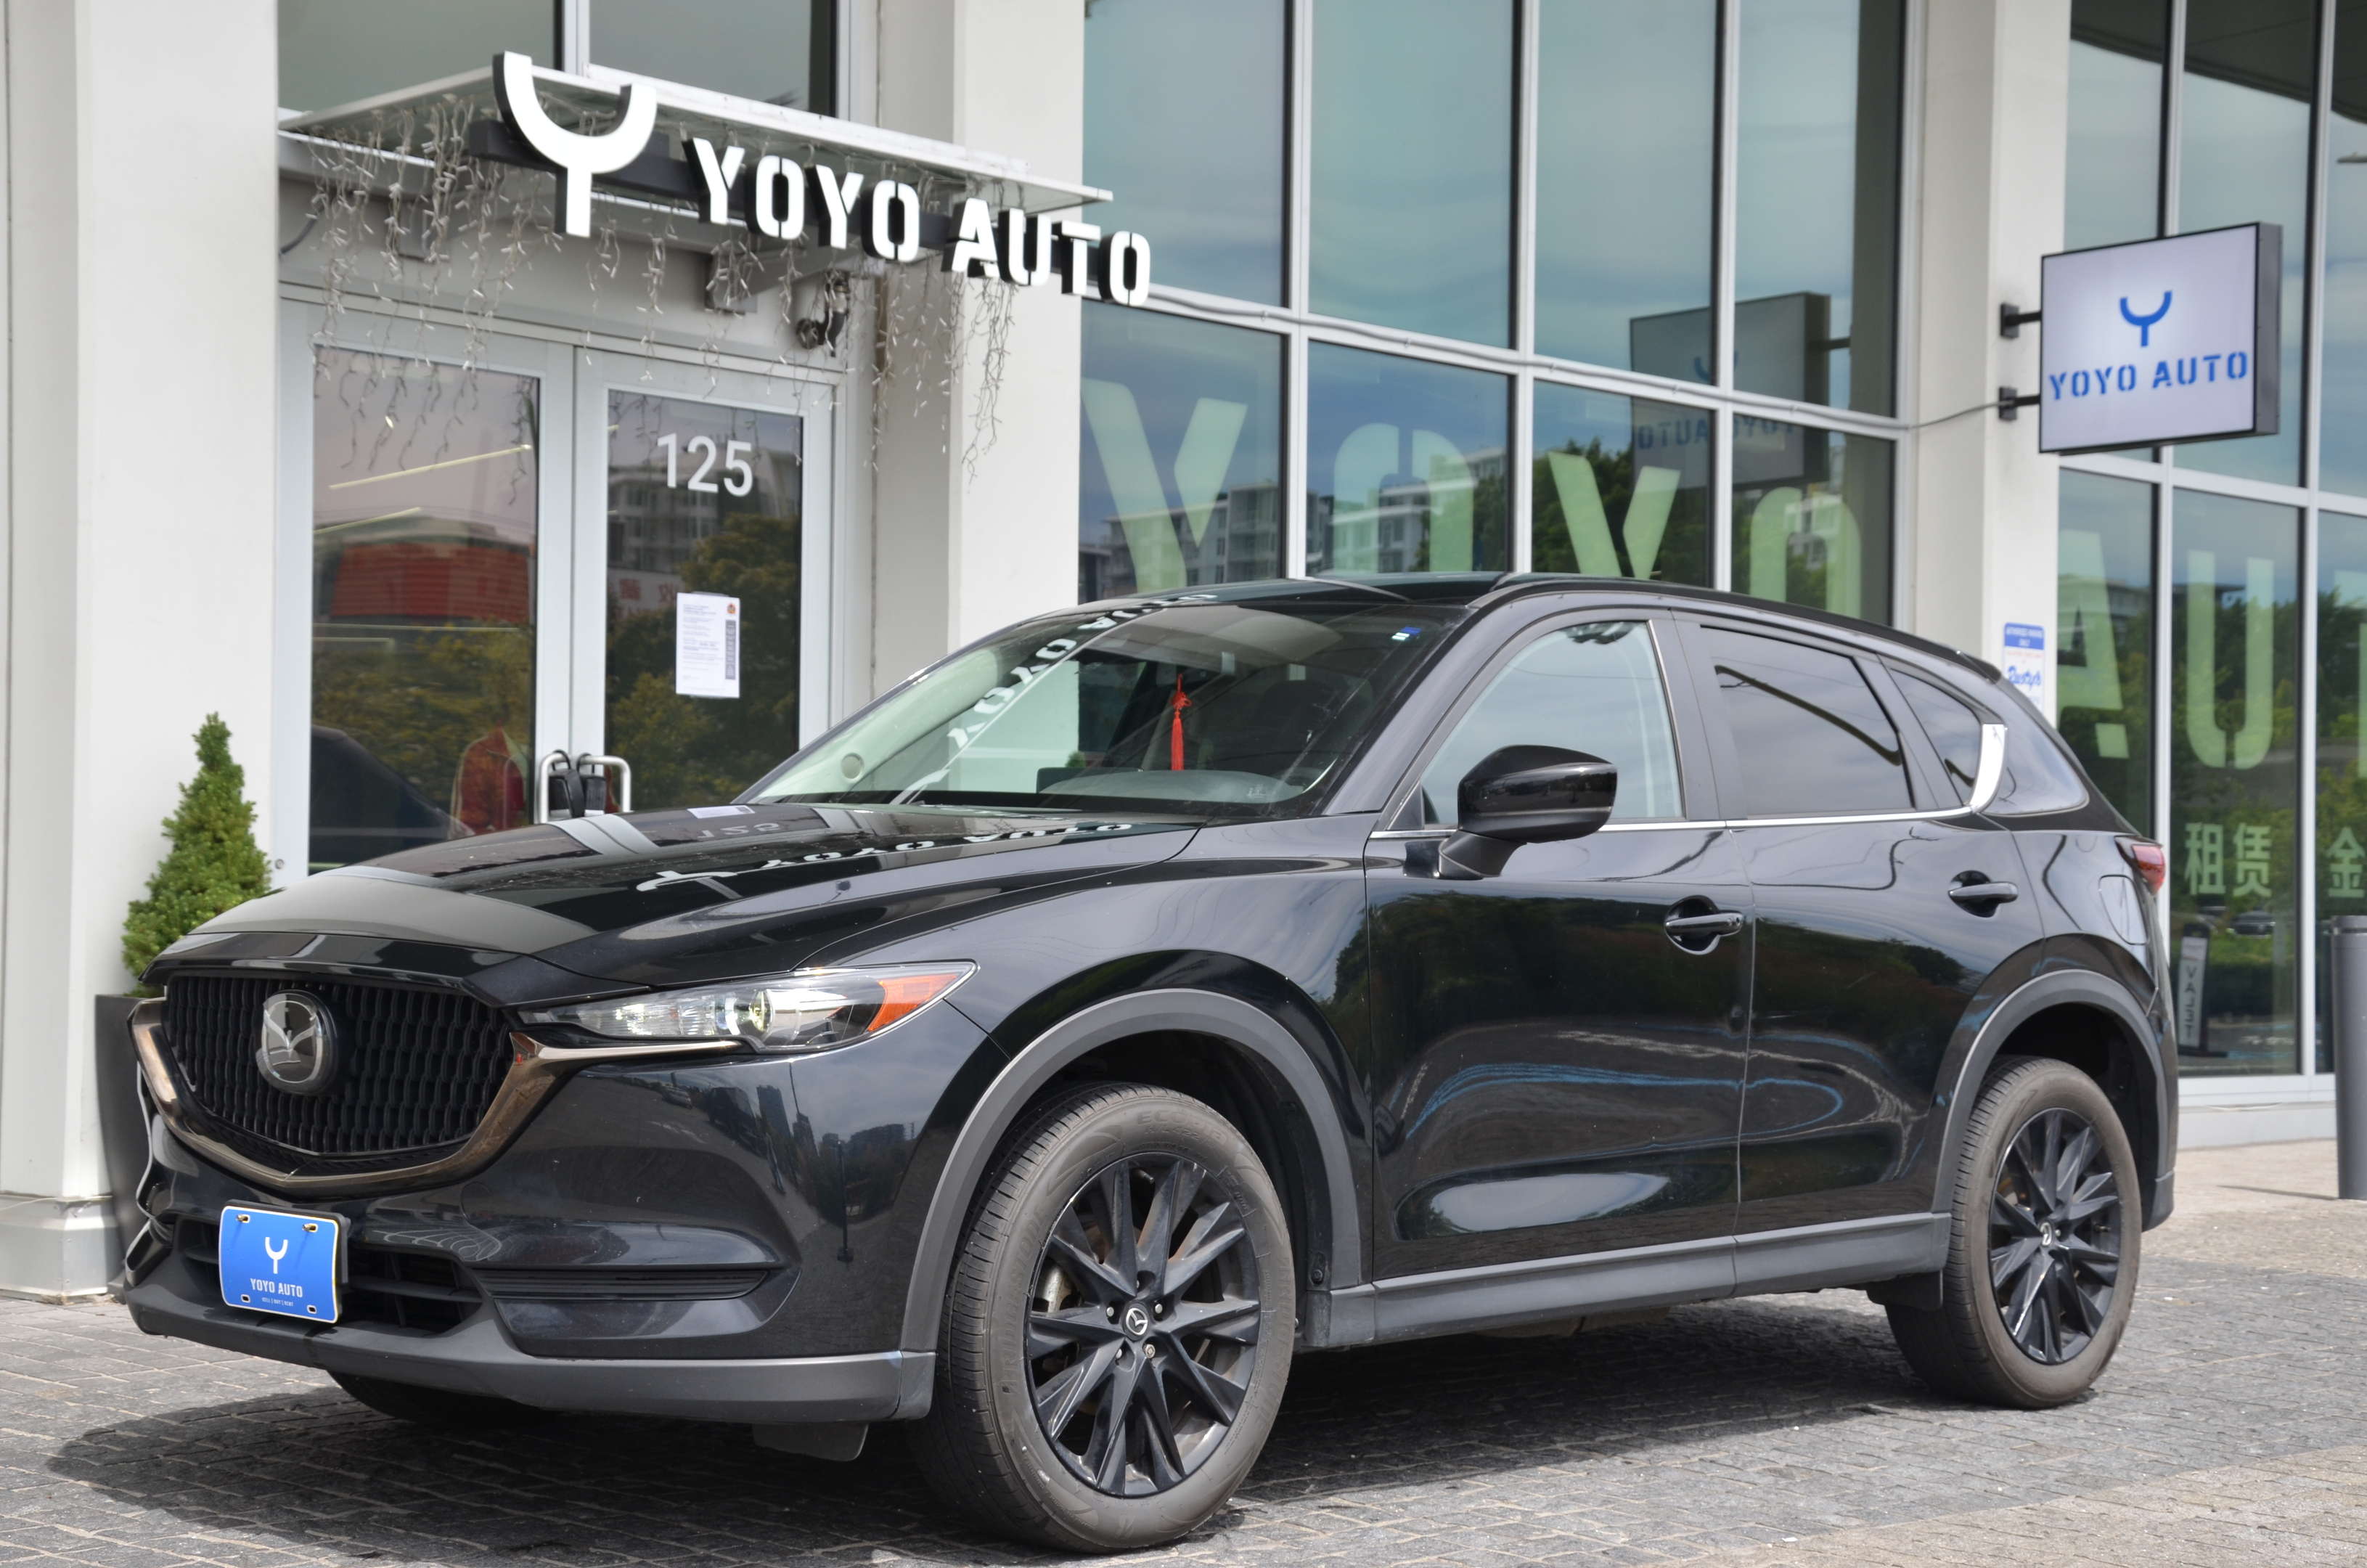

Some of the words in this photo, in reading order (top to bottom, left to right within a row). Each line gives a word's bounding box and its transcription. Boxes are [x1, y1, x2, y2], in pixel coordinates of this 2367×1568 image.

[683, 137, 920, 261] YOYO
[943, 198, 1150, 306] AUTO
[2049, 364, 2137, 401] YOYO
[2152, 351, 2248, 389] AUTO
[657, 433, 753, 497] 125
[2184, 822, 2273, 897] 租赁
[2327, 826, 2366, 898] 金
[250, 1278, 275, 1293] YOYO
[278, 1283, 303, 1298] AUTO
